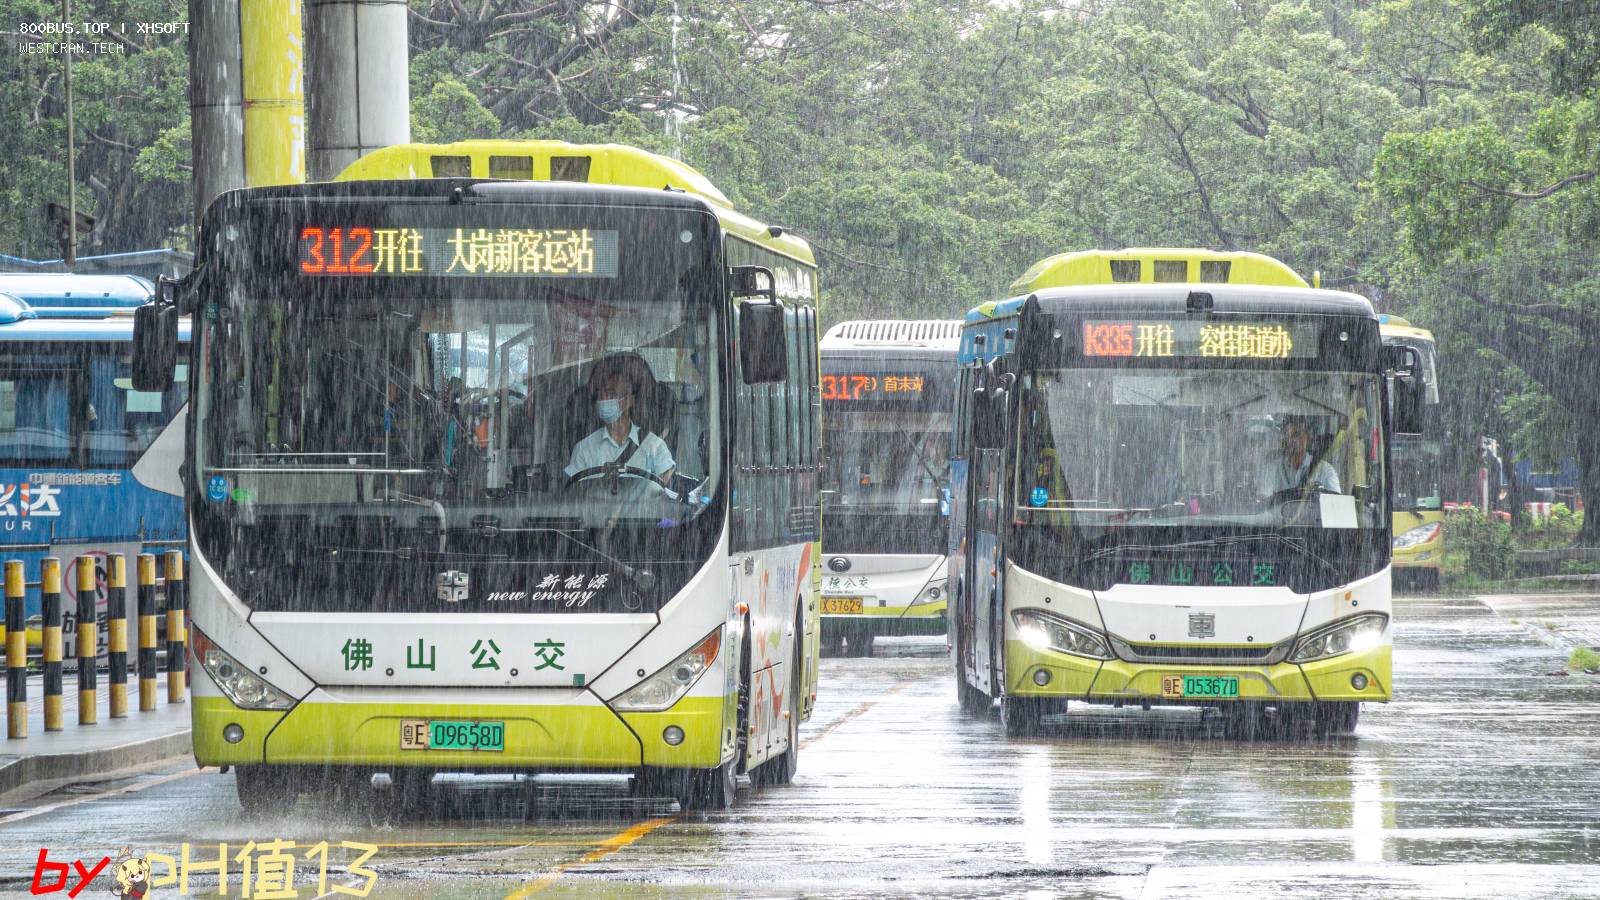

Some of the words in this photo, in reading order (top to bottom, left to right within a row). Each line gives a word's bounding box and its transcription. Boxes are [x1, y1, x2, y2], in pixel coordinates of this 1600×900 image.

[301, 227, 373, 274] 312
[446, 229, 593, 273] 大岗新客运站
[822, 375, 867, 400] 317
[536, 573, 609, 591] 新能源
[820, 576, 870, 589] 德公交
[1129, 561, 1275, 585] 佛山公交
[487, 591, 528, 601] new
[532, 590, 597, 607] energy
[341, 638, 565, 671] 佛山公交
[434, 724, 503, 746] 09658D
